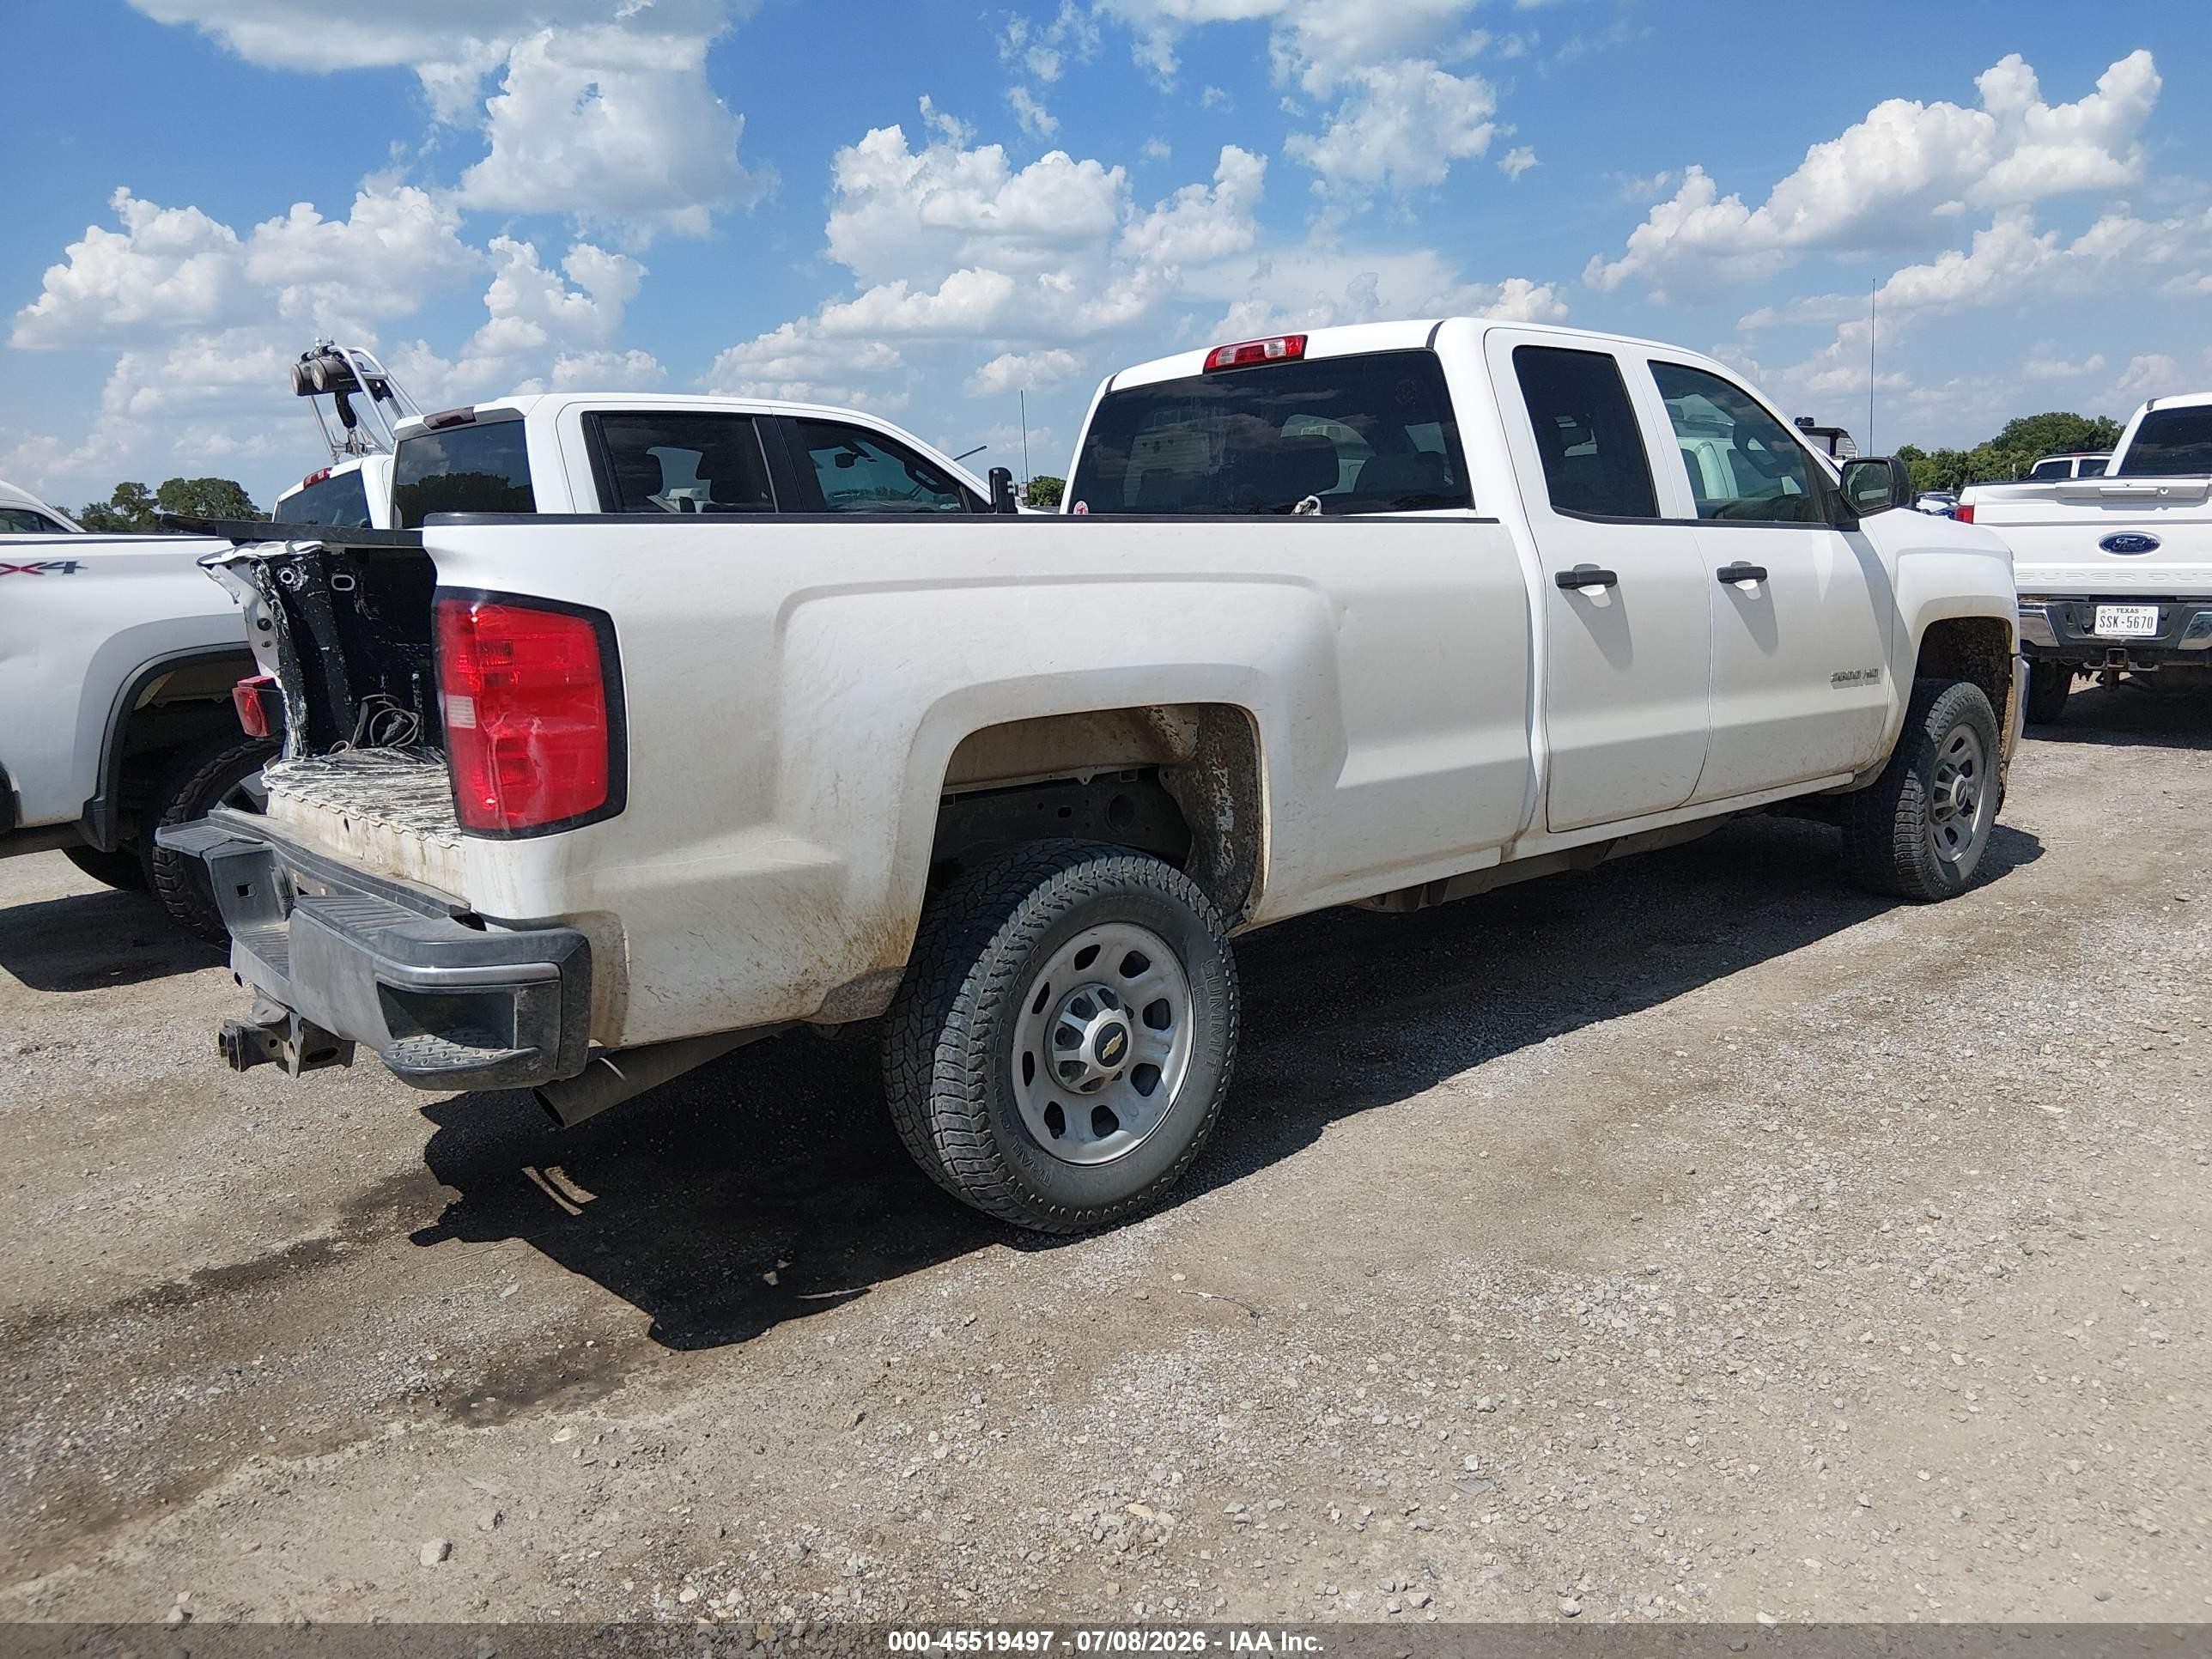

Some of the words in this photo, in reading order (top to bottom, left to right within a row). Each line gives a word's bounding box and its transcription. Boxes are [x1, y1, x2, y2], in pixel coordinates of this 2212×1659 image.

[2112, 537, 2146, 550] Ford
[2015, 571, 2137, 582] SUPER
[1200, 959, 1225, 1076] SUMMIT
